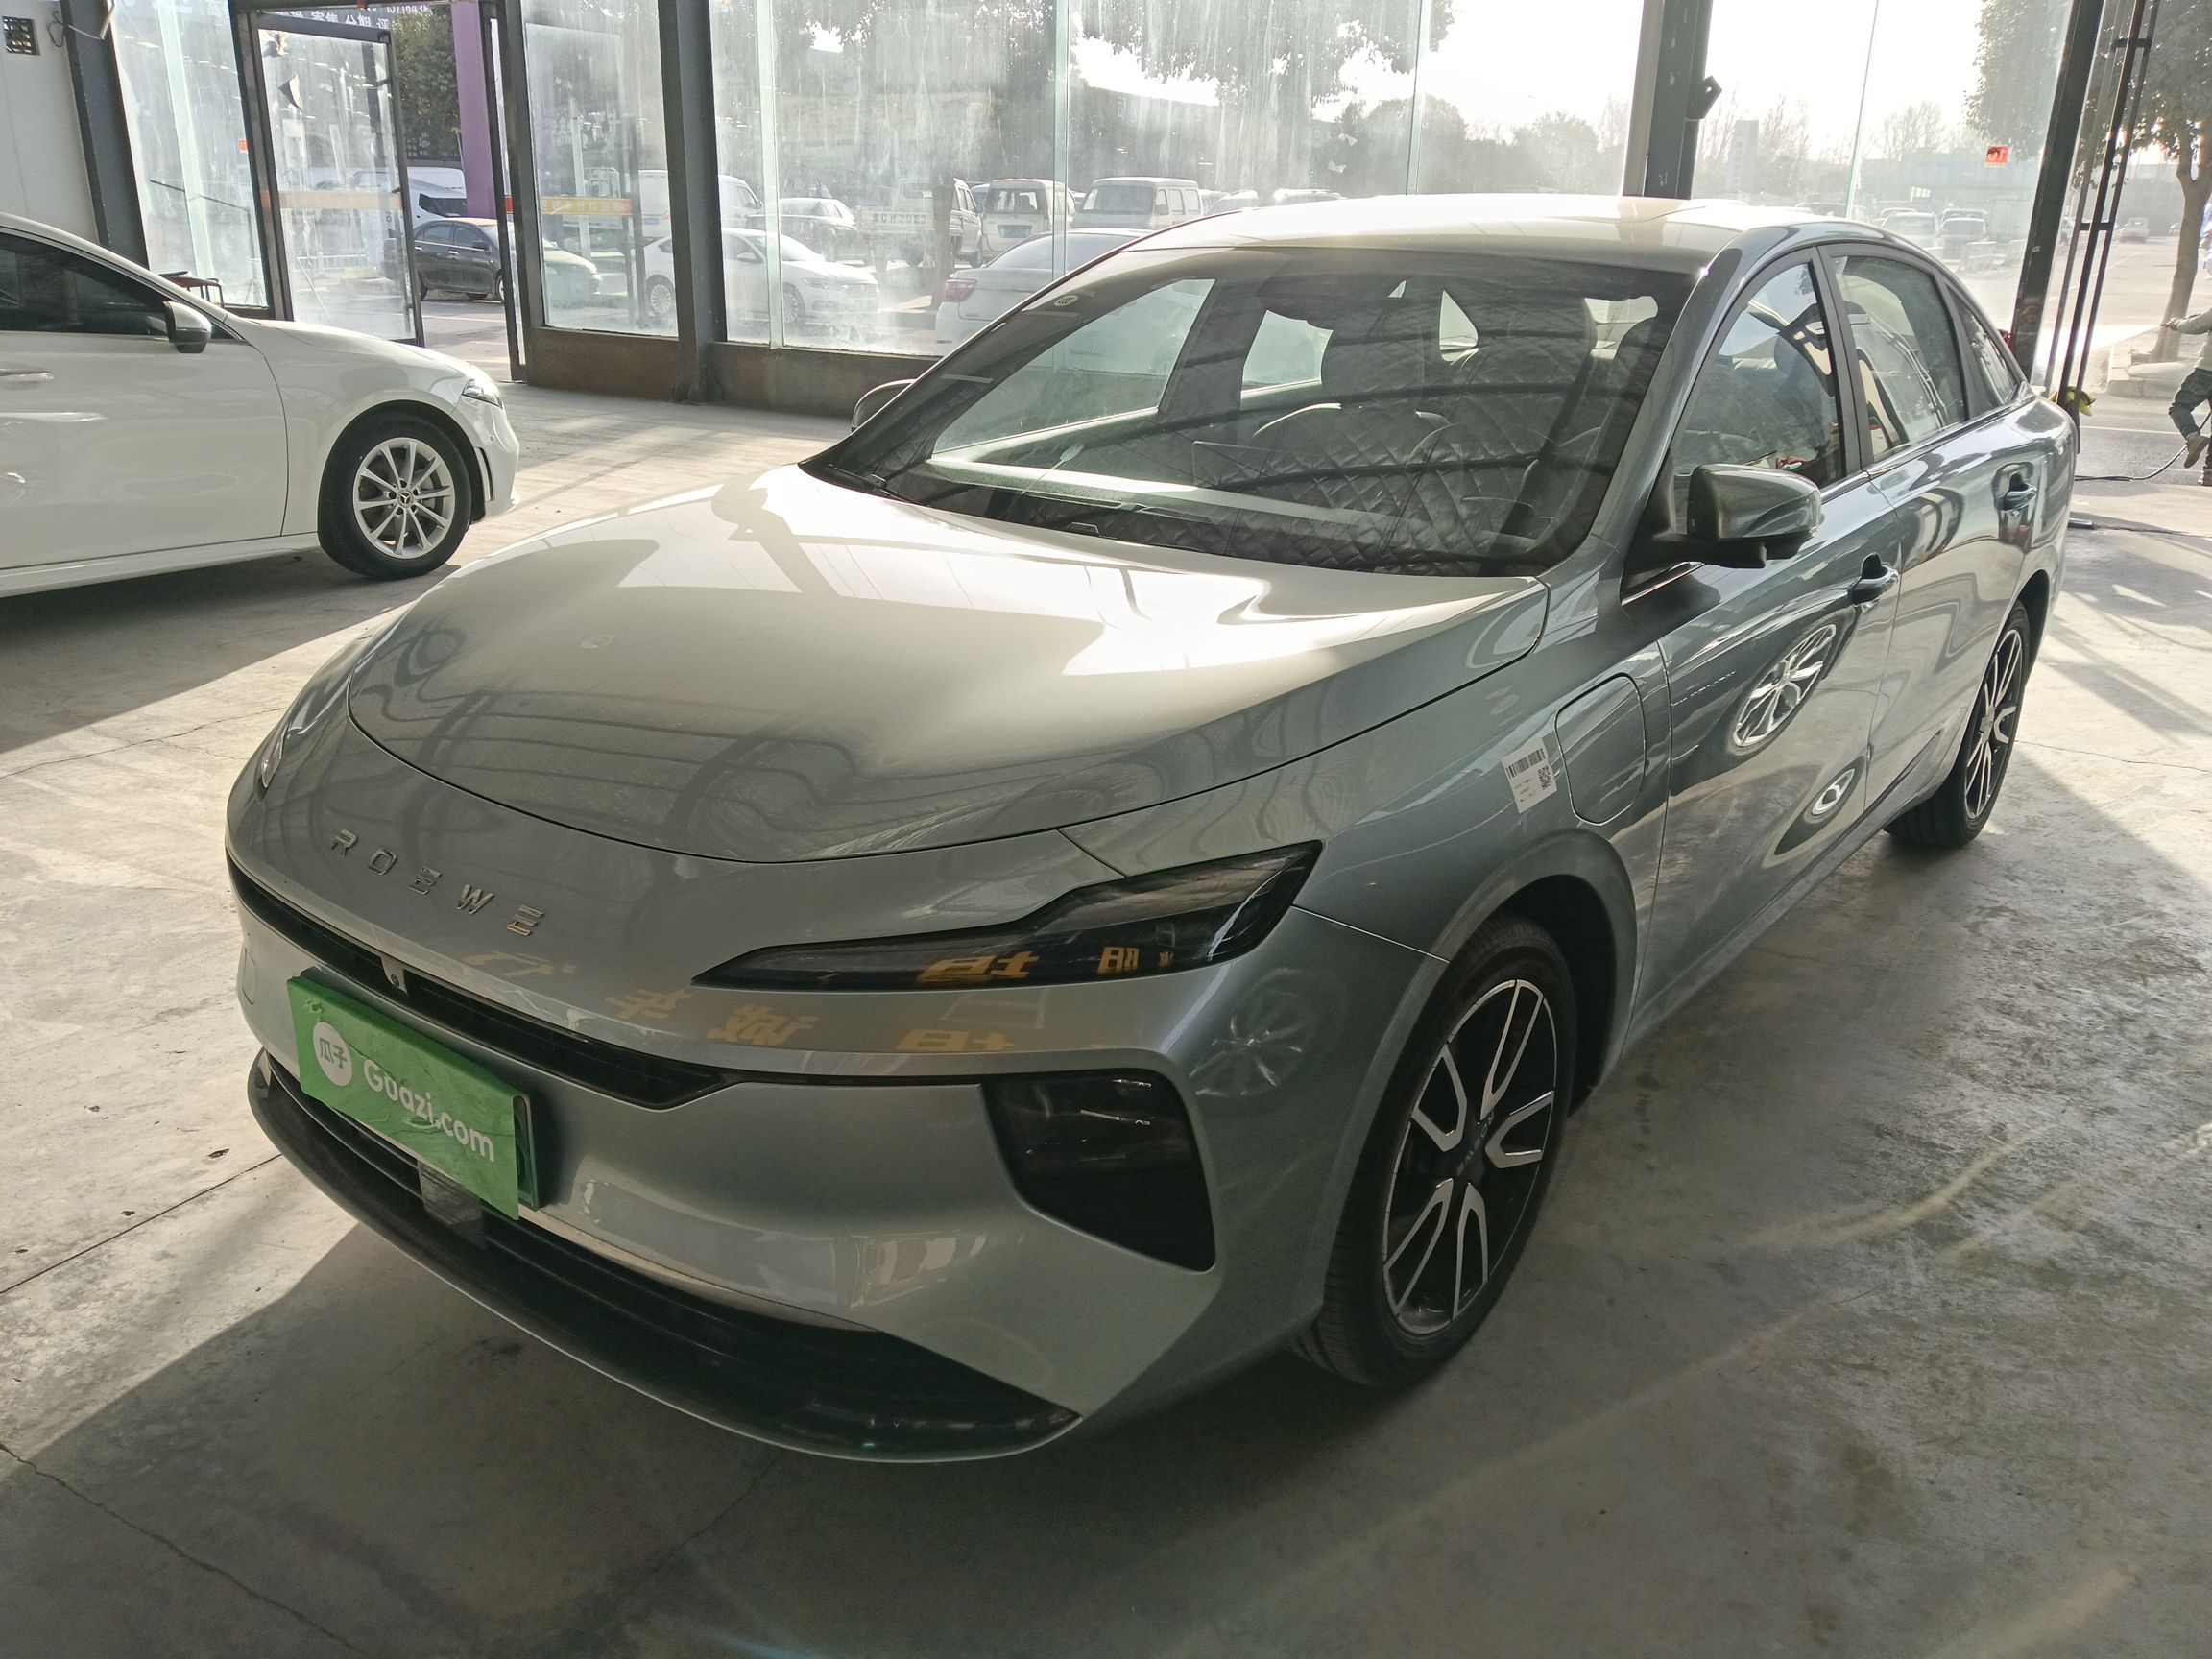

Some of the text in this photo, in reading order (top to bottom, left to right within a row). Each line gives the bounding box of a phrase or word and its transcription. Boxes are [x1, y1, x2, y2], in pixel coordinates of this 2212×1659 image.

[330, 829, 544, 936] ROEWE
[319, 1037, 348, 1069] 瓜子
[363, 1058, 495, 1163] Guazi.com
